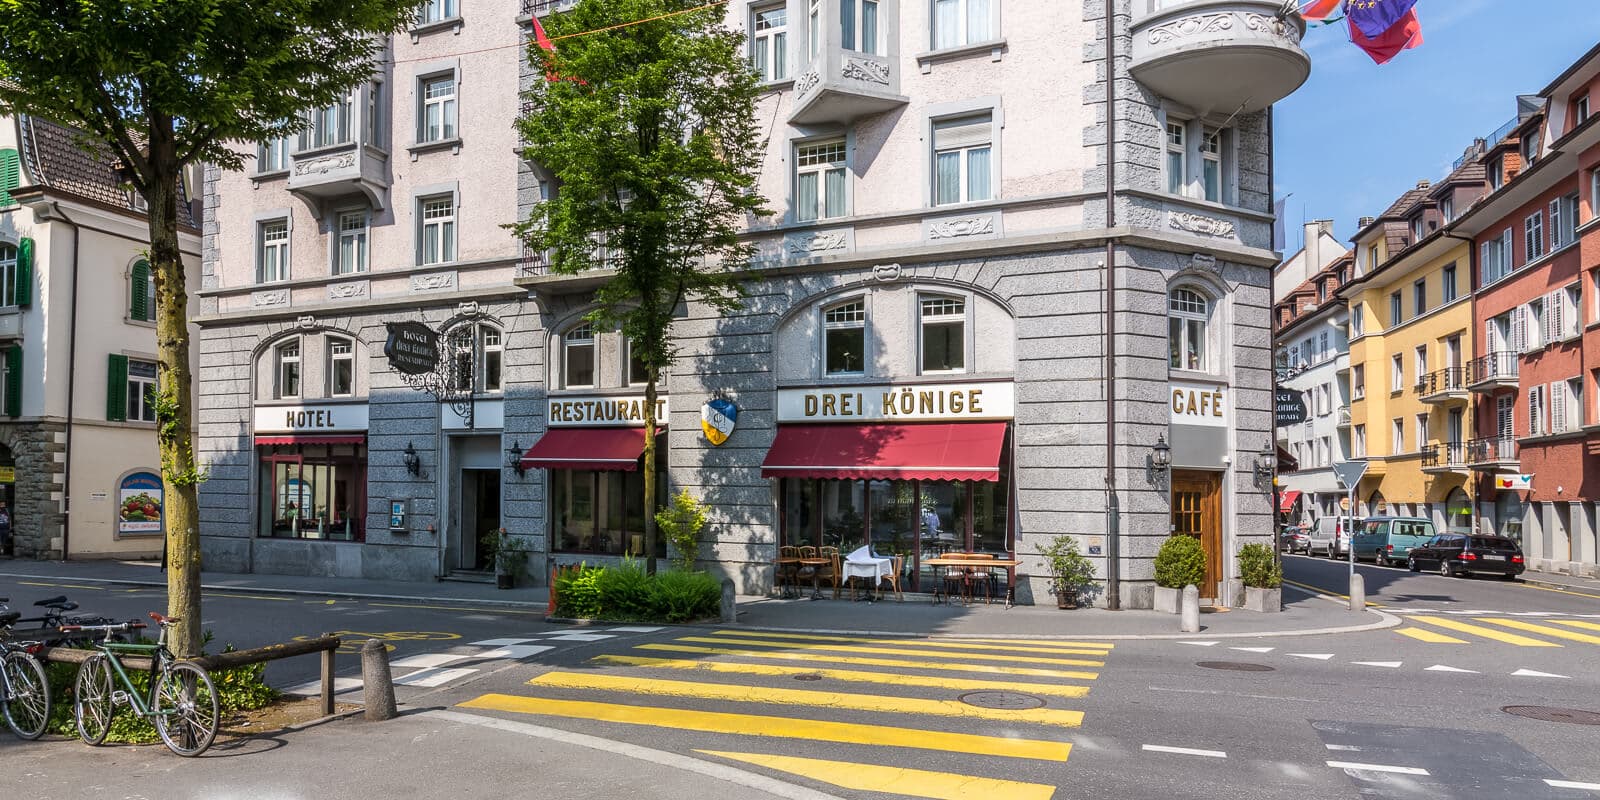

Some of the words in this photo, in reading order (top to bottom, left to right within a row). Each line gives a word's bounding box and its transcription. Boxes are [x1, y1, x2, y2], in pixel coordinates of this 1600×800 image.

[804, 393, 863, 417] DREI
[882, 388, 983, 415] KÖNIGE
[1172, 386, 1223, 417] CAFÉ
[286, 409, 335, 428] HOTEL
